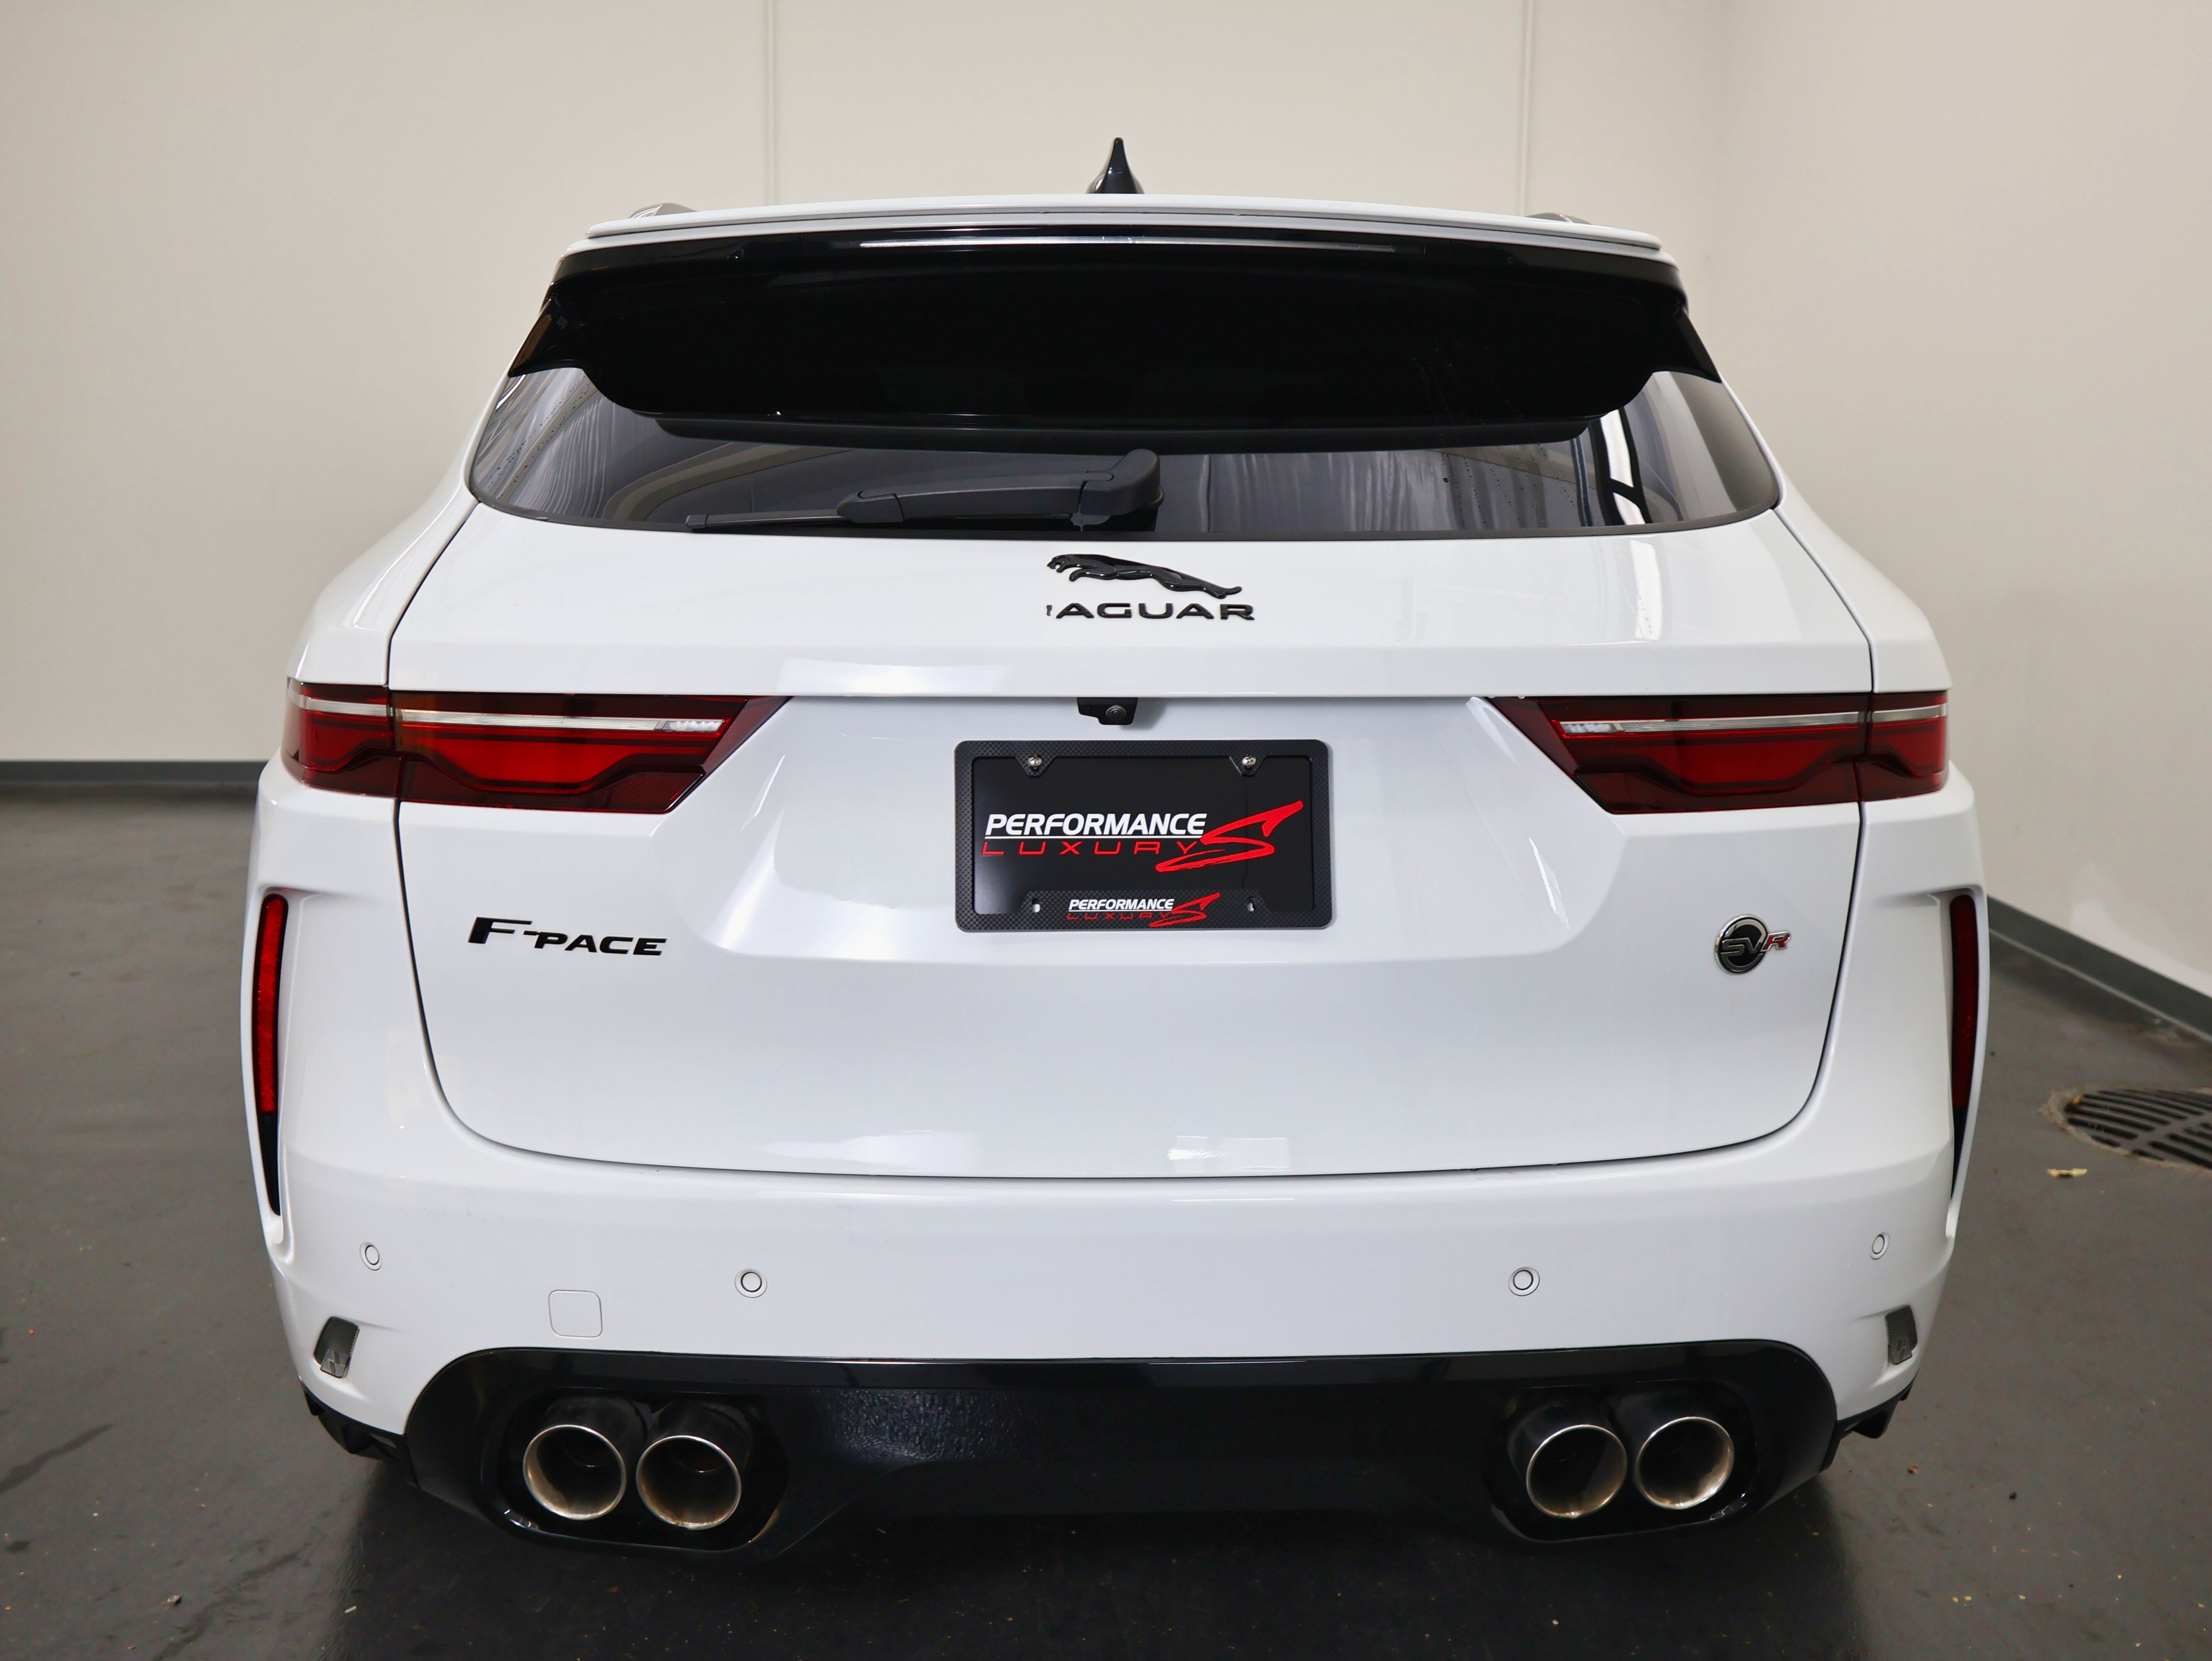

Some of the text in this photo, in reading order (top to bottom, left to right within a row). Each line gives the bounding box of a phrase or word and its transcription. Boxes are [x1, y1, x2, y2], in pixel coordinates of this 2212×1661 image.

[984, 813, 1208, 835] PERFORMANCE
[1068, 899, 1175, 910] PERFORMANCE
[467, 916, 668, 956] F-PACE
